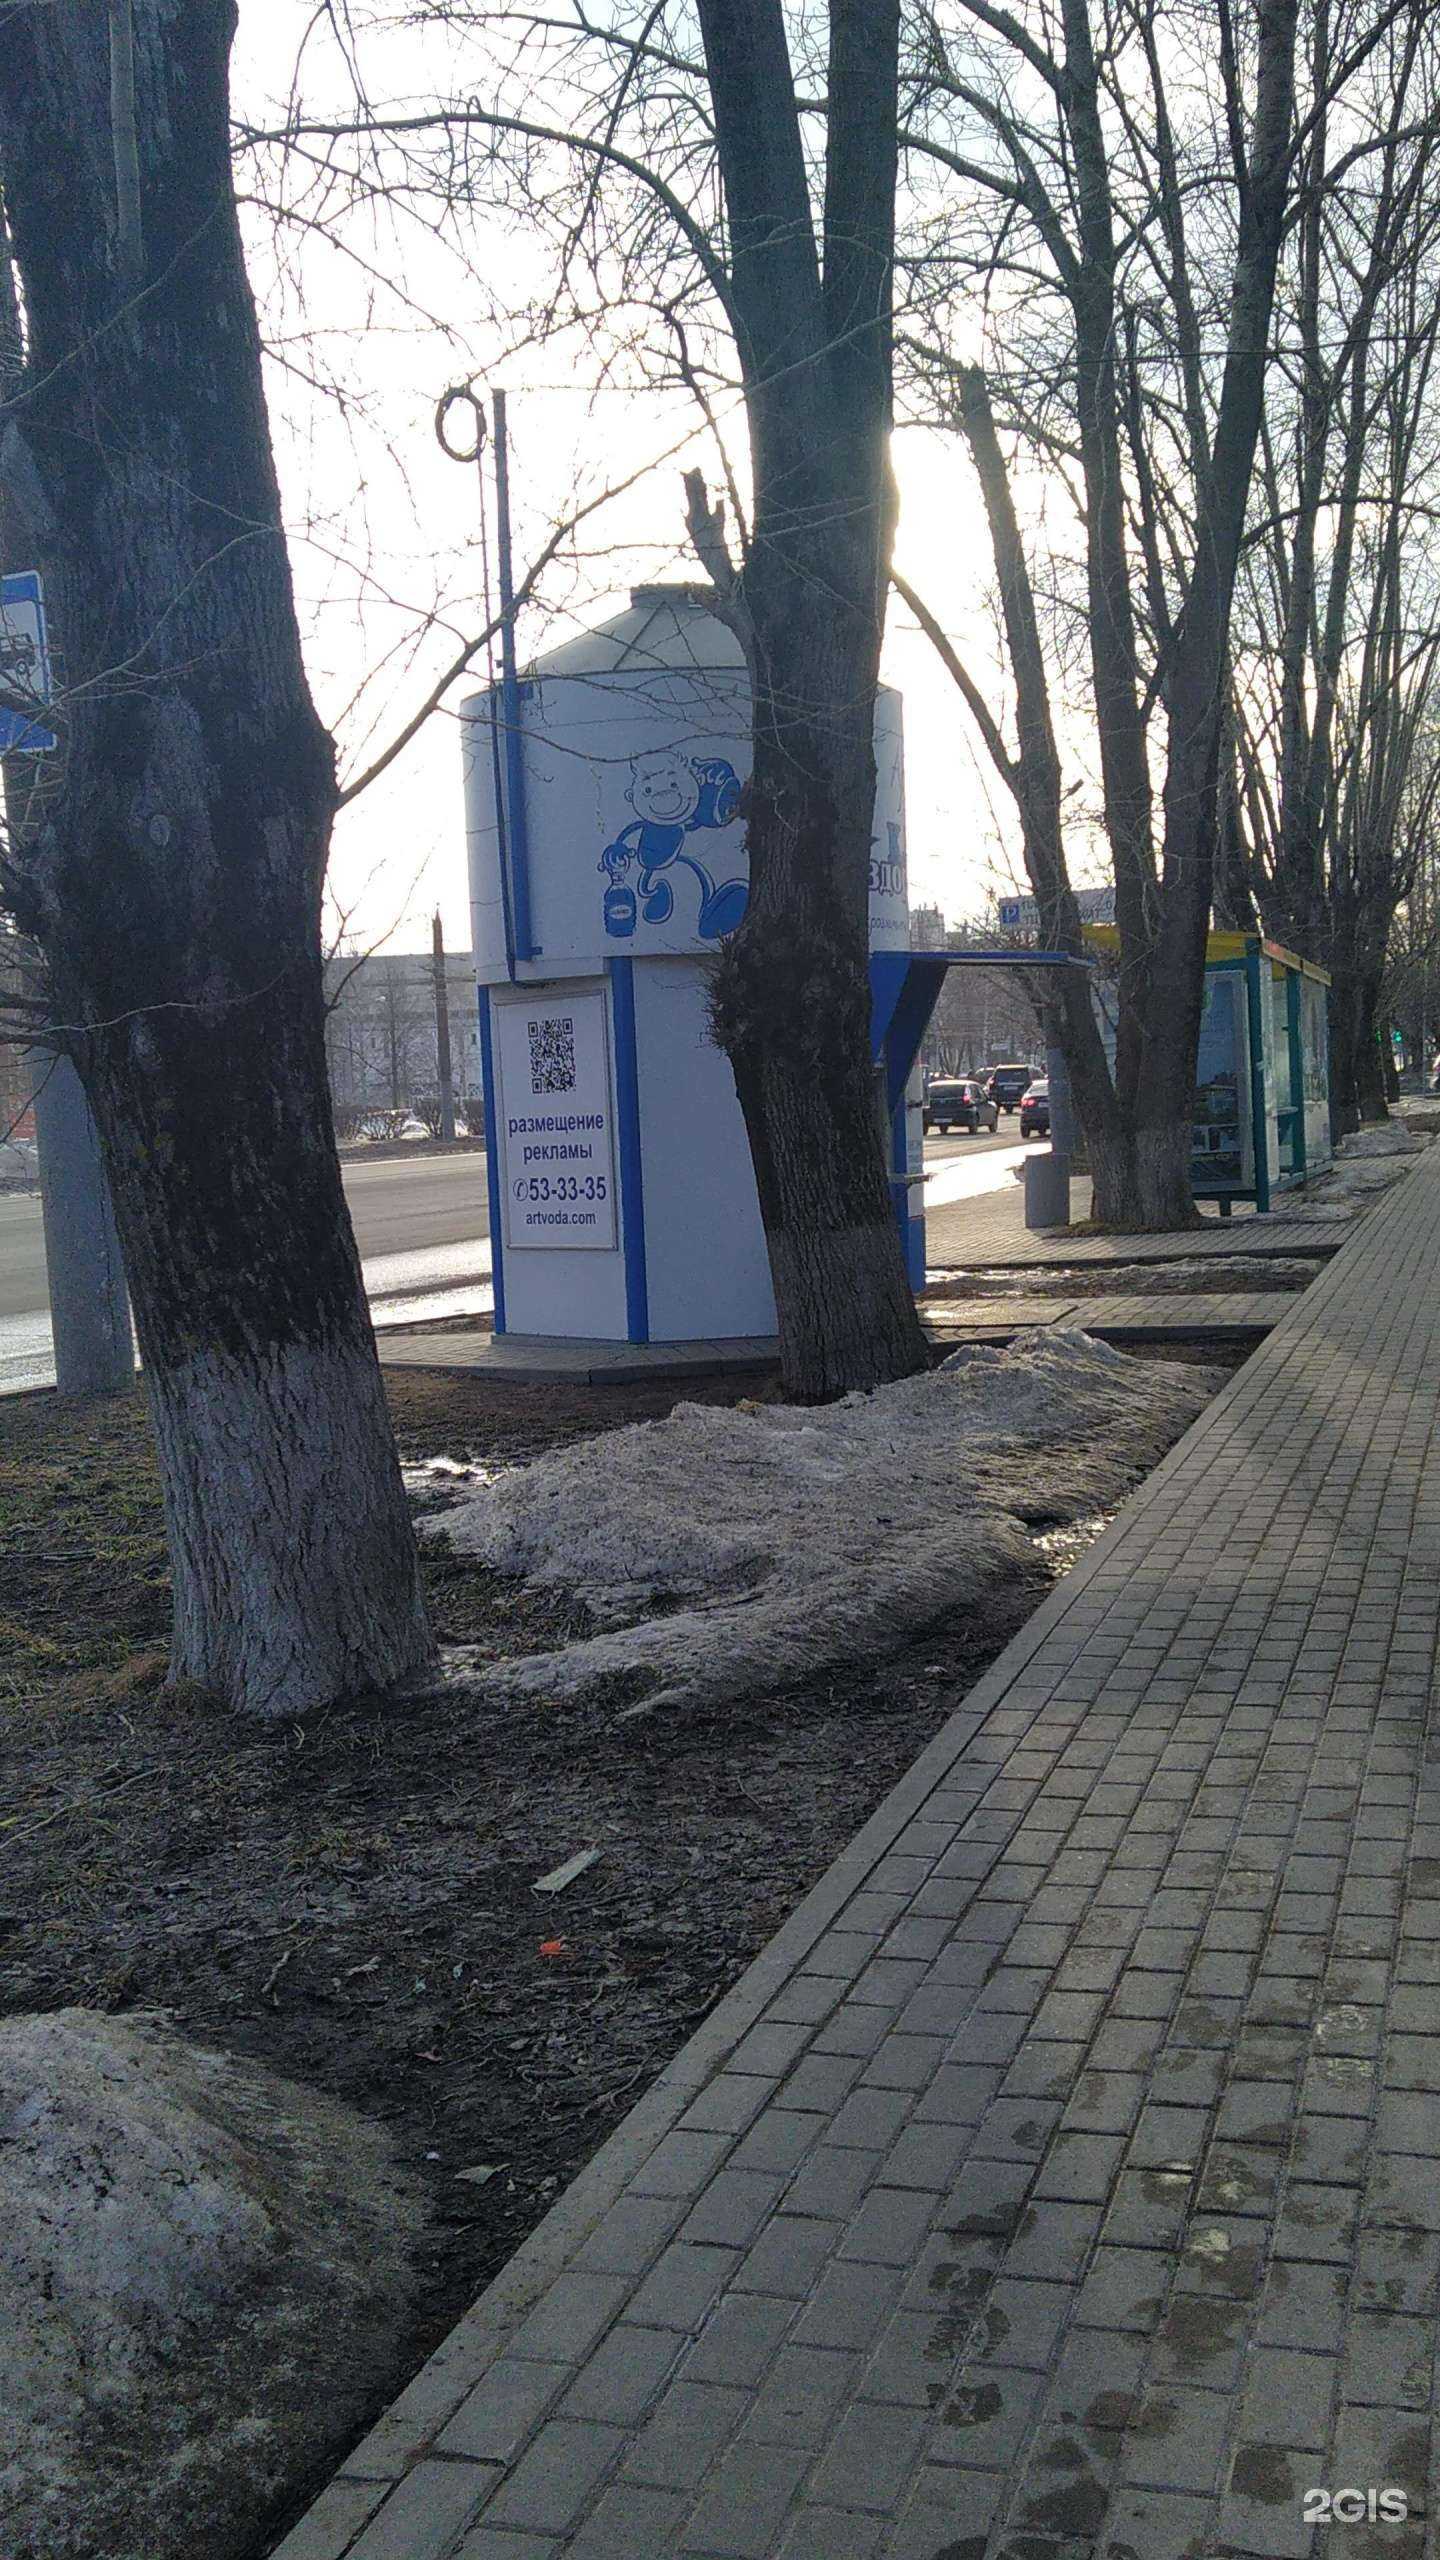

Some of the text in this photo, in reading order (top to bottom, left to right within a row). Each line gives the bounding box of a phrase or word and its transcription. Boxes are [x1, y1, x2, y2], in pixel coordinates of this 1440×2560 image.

[508, 1113, 604, 1137] размещение
[523, 1144, 593, 1165] рекламы
[529, 1176, 607, 1201] 53-33-35
[525, 1210, 596, 1225] artvoda.com
